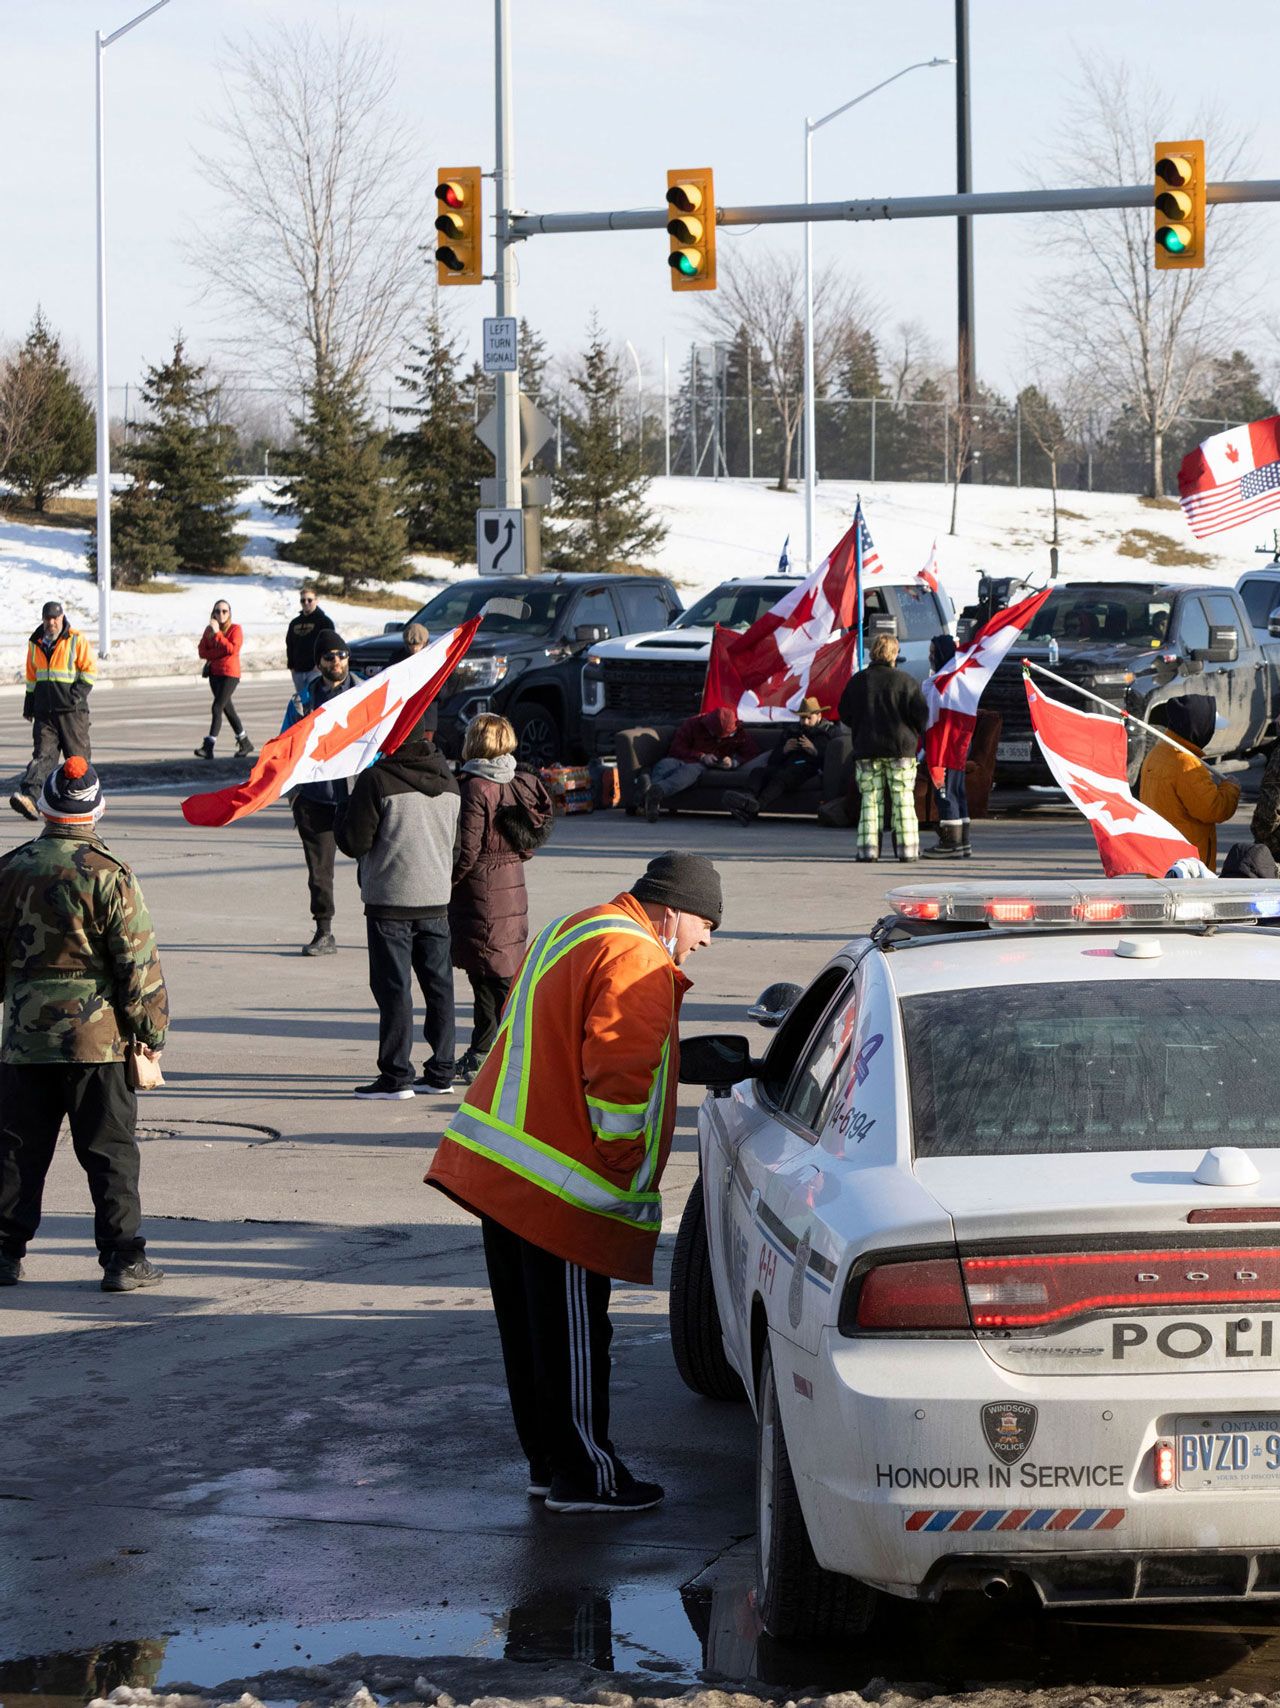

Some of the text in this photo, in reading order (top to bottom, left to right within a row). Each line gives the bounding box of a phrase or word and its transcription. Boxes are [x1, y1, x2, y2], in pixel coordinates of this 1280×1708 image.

[490, 324, 510, 335] LEFT
[490, 338, 511, 348] TURN
[486, 353, 515, 363] SIGNAL
[988, 1404, 1031, 1415] WINDSOR
[1221, 1421, 1279, 1433] ONTARIO
[1182, 1434, 1250, 1471] BVZD
[876, 1462, 1124, 1488] HONOUR IN SERVICE
